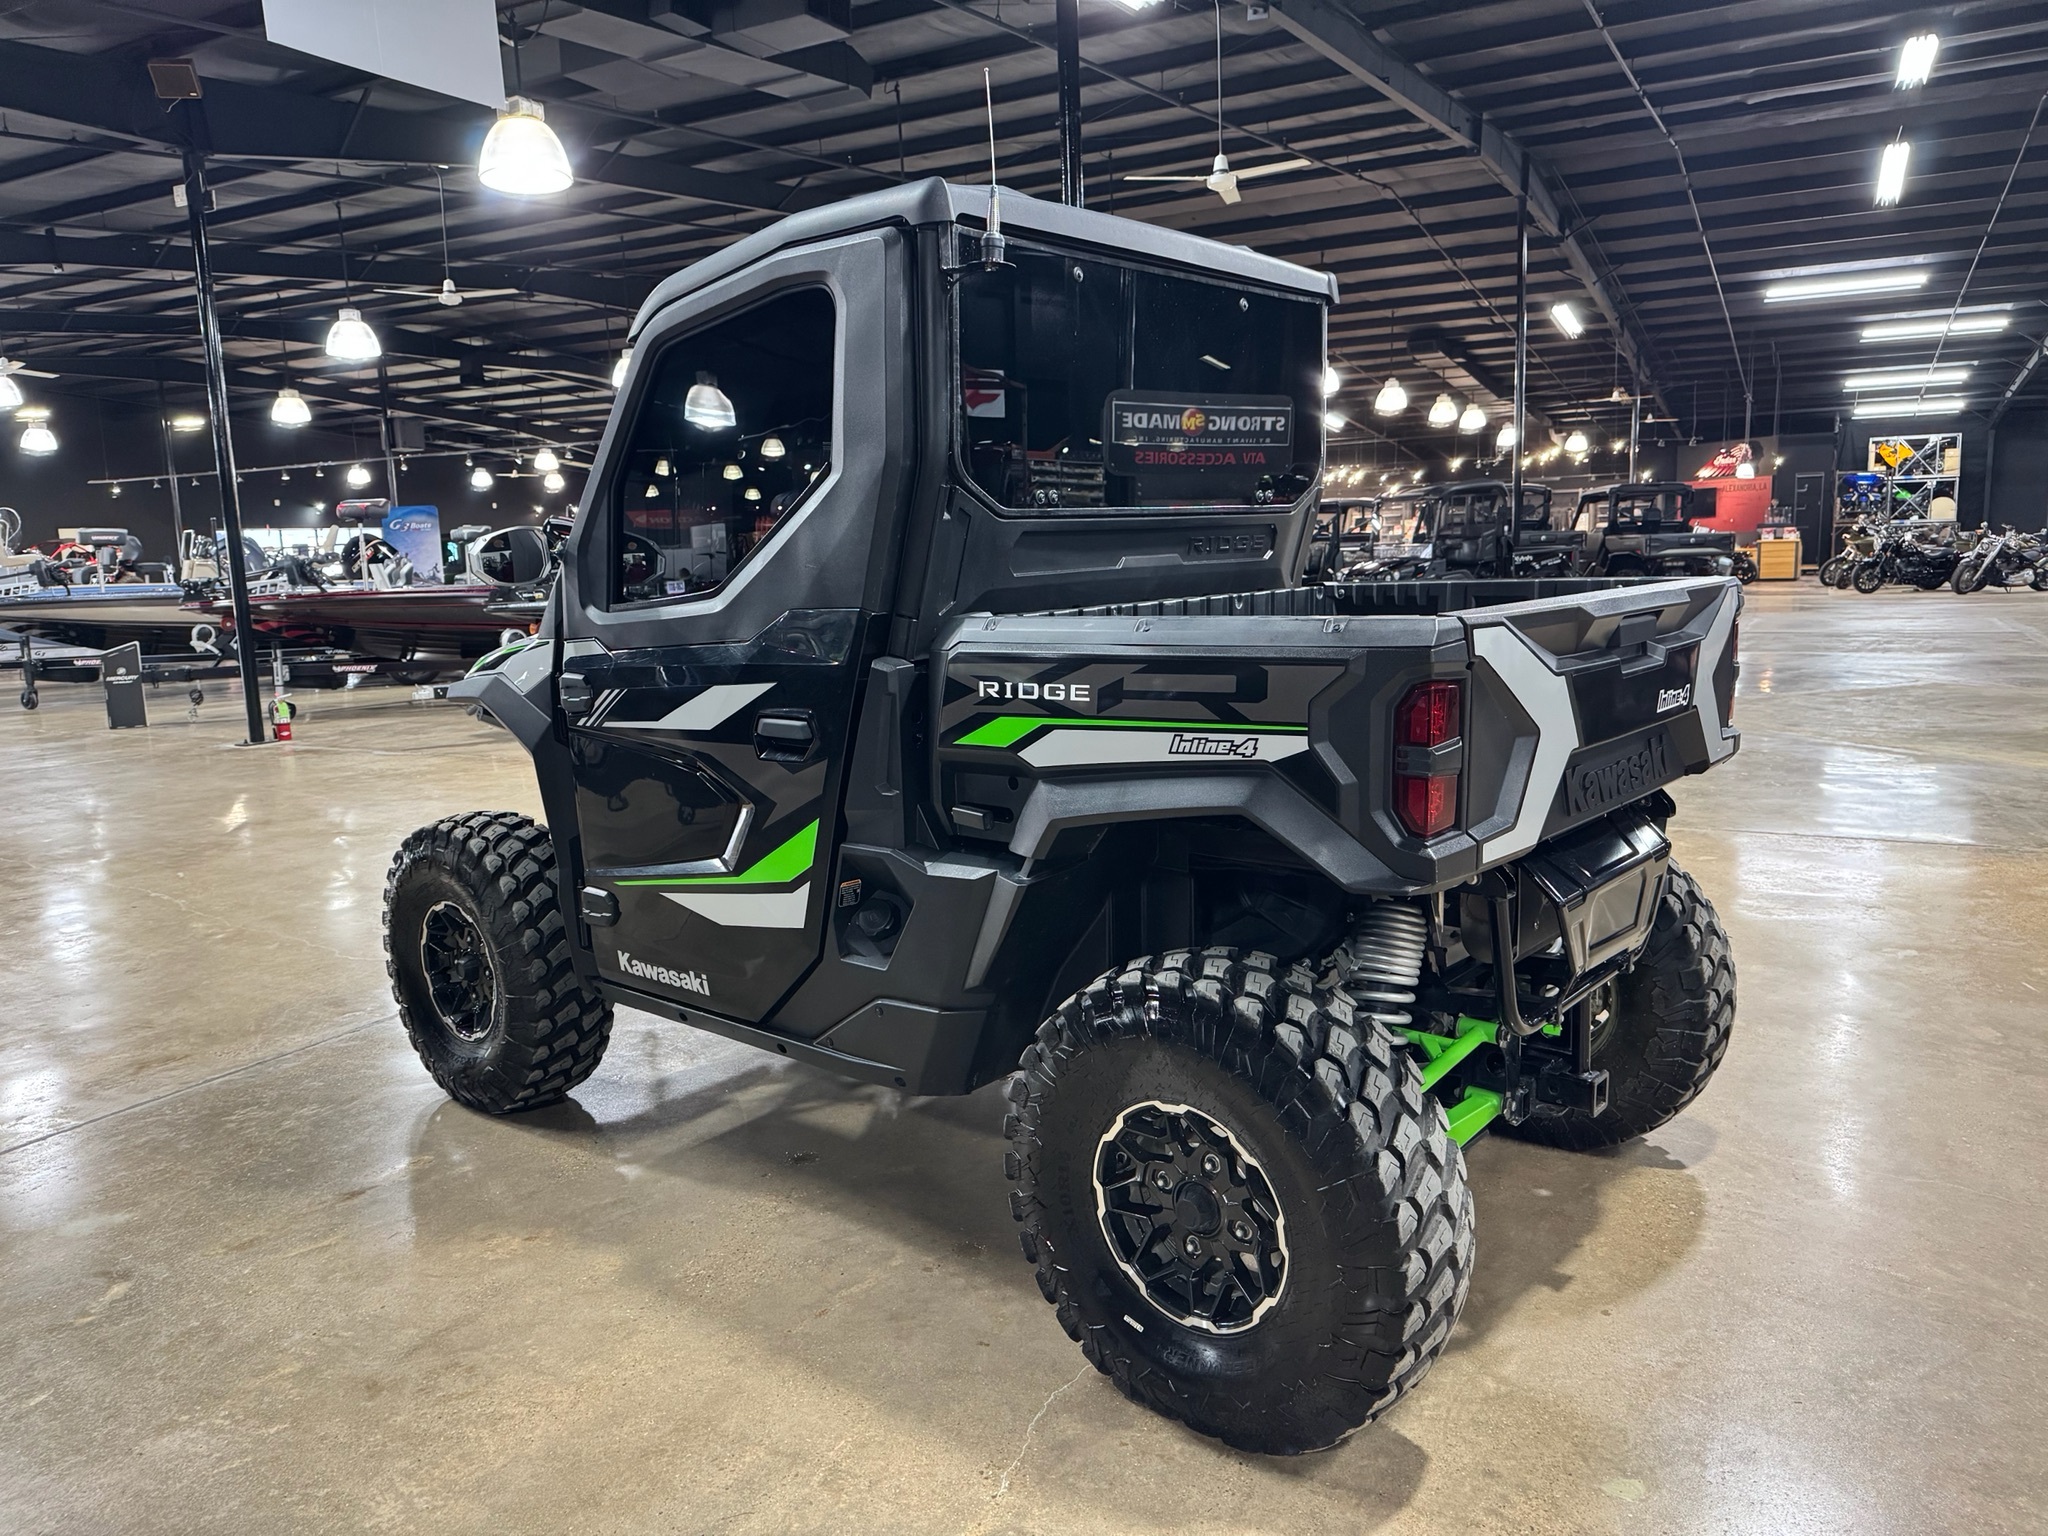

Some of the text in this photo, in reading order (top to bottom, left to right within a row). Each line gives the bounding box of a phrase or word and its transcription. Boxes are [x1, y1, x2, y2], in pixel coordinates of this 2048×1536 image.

[1187, 534, 1265, 555] RIDGE
[105, 674, 139, 682] MERCURY
[341, 664, 378, 673] PHOENIX
[978, 680, 1091, 702] RIDGE
[1168, 734, 1259, 758] Inline-4
[1565, 735, 1671, 817] Kawasaki
[617, 949, 711, 997] Kawasaki
